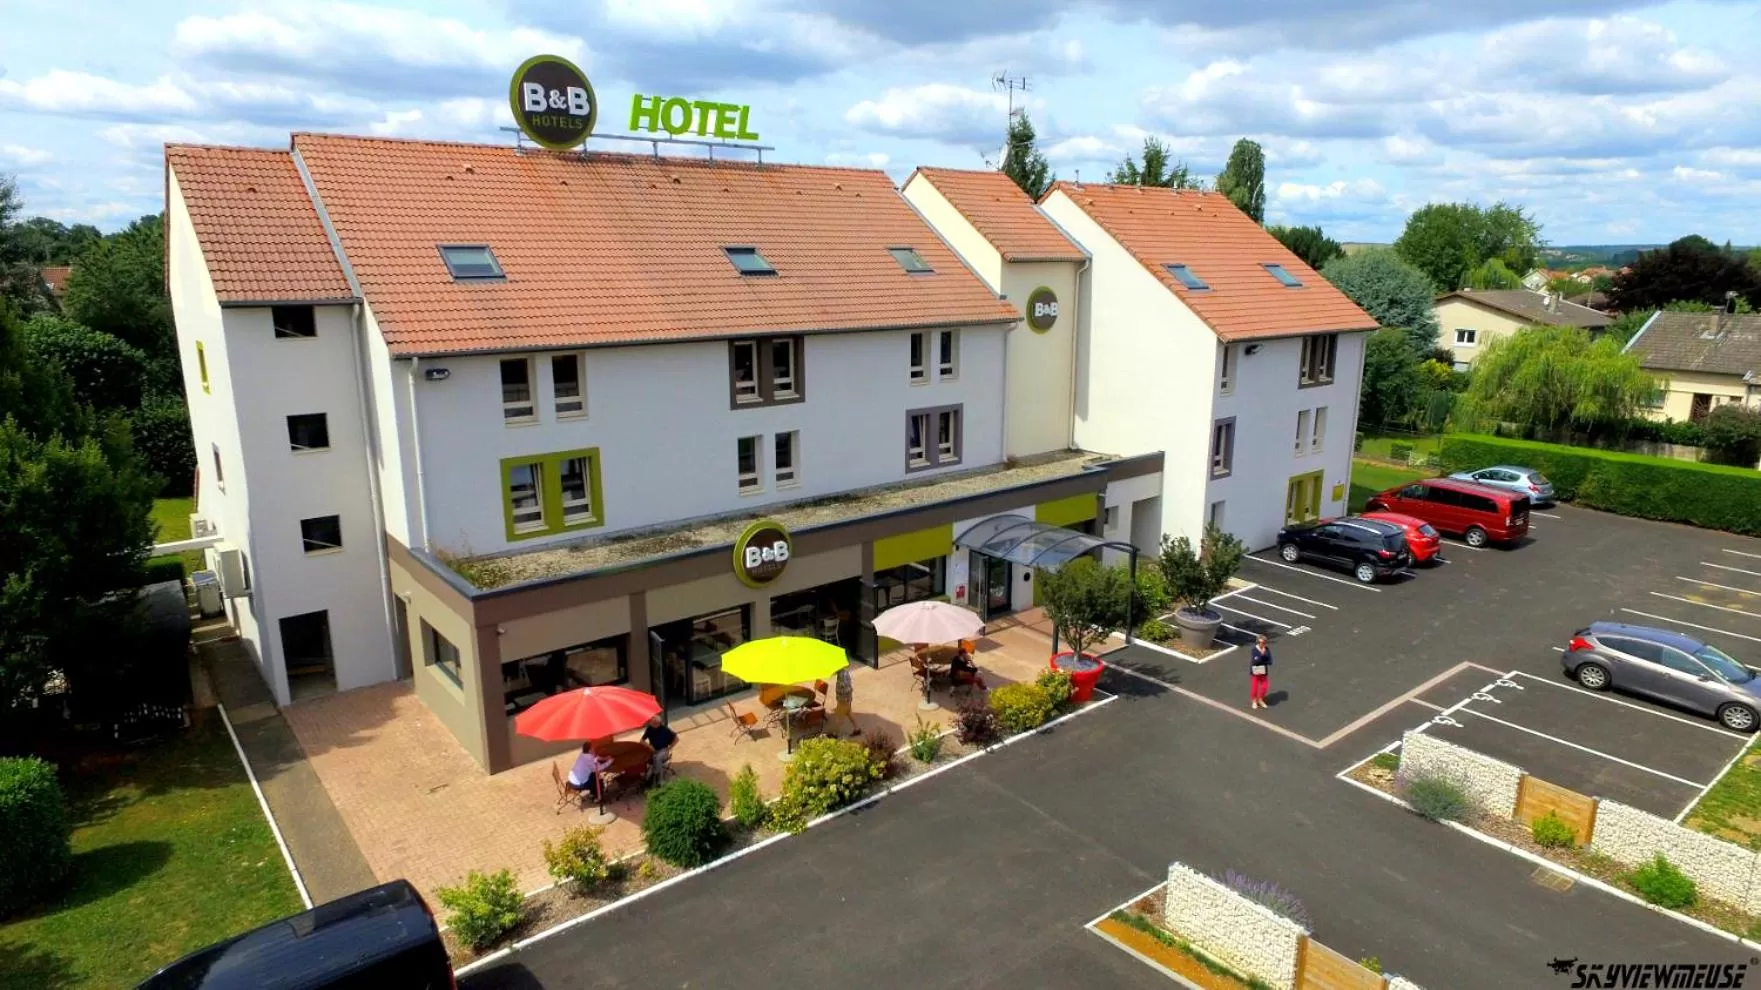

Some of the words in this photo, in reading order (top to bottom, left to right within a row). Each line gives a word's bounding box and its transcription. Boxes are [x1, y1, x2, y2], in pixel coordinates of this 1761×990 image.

[524, 82, 591, 116] B&B
[532, 114, 584, 130] HOTELS
[629, 93, 759, 141] HOTEL
[1035, 302, 1058, 317] B&B
[746, 541, 789, 569] B&B
